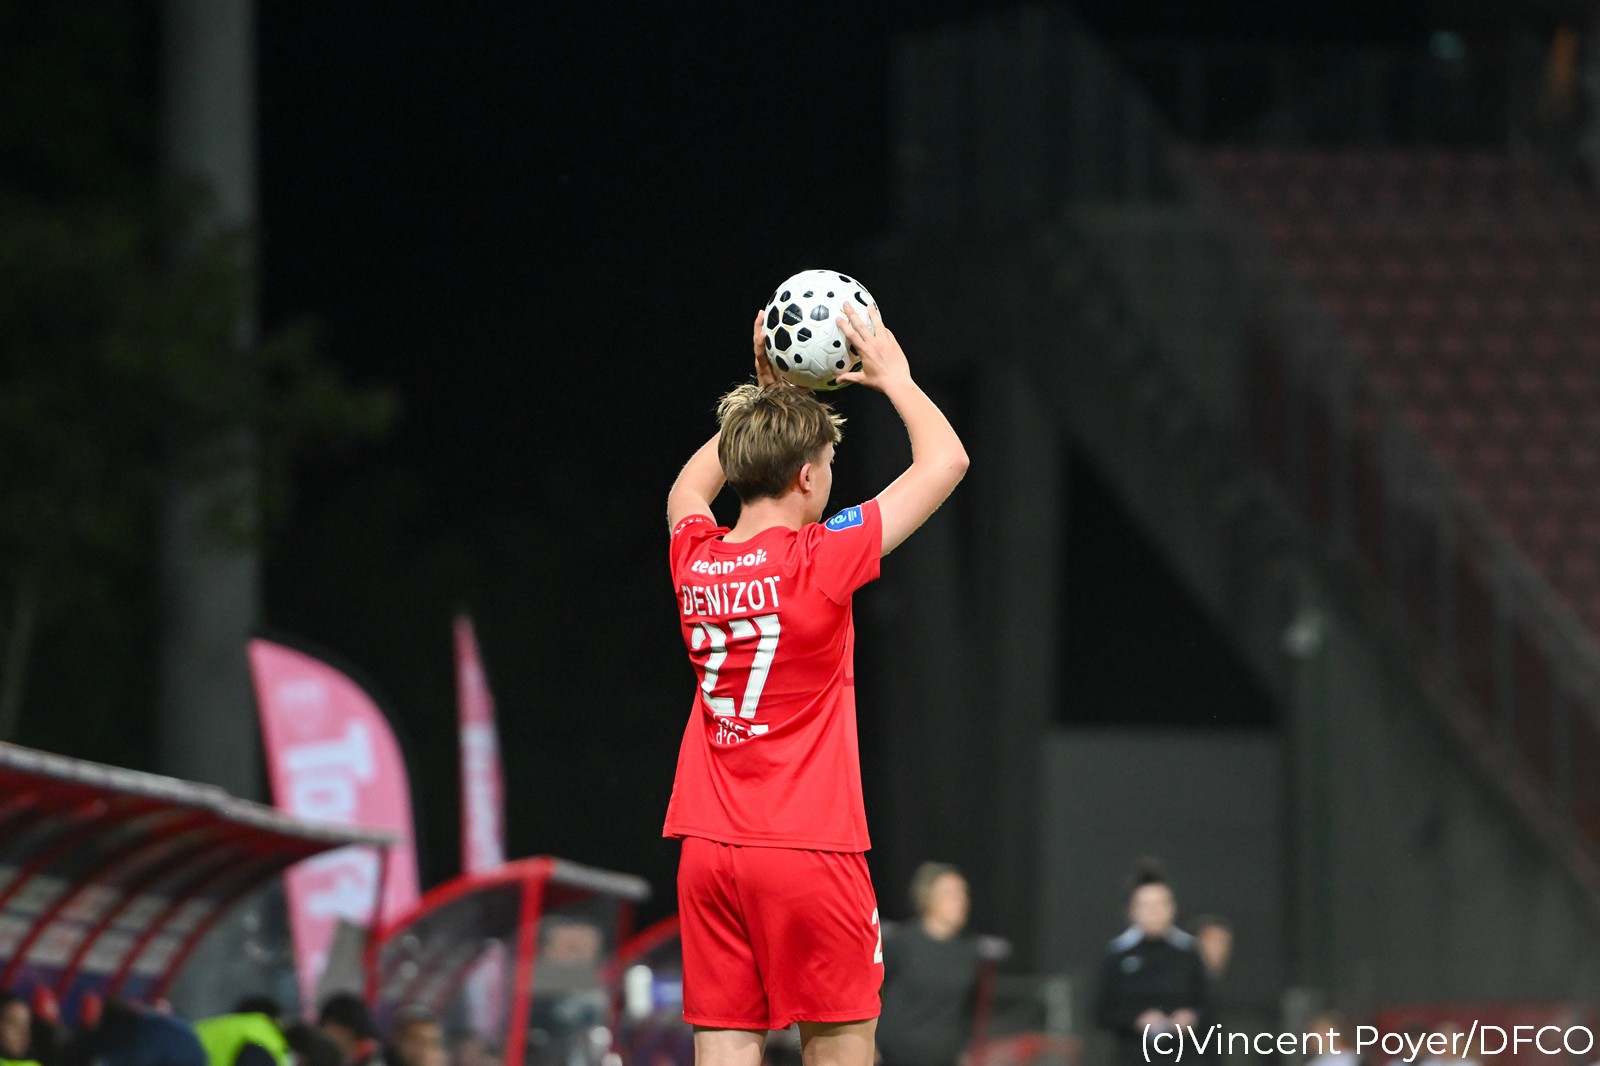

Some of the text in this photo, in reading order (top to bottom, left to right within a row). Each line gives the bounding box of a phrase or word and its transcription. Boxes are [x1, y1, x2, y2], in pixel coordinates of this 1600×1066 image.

[681, 576, 780, 616] DENIZOT
[691, 613, 781, 718] 27
[716, 724, 746, 744] d'O
